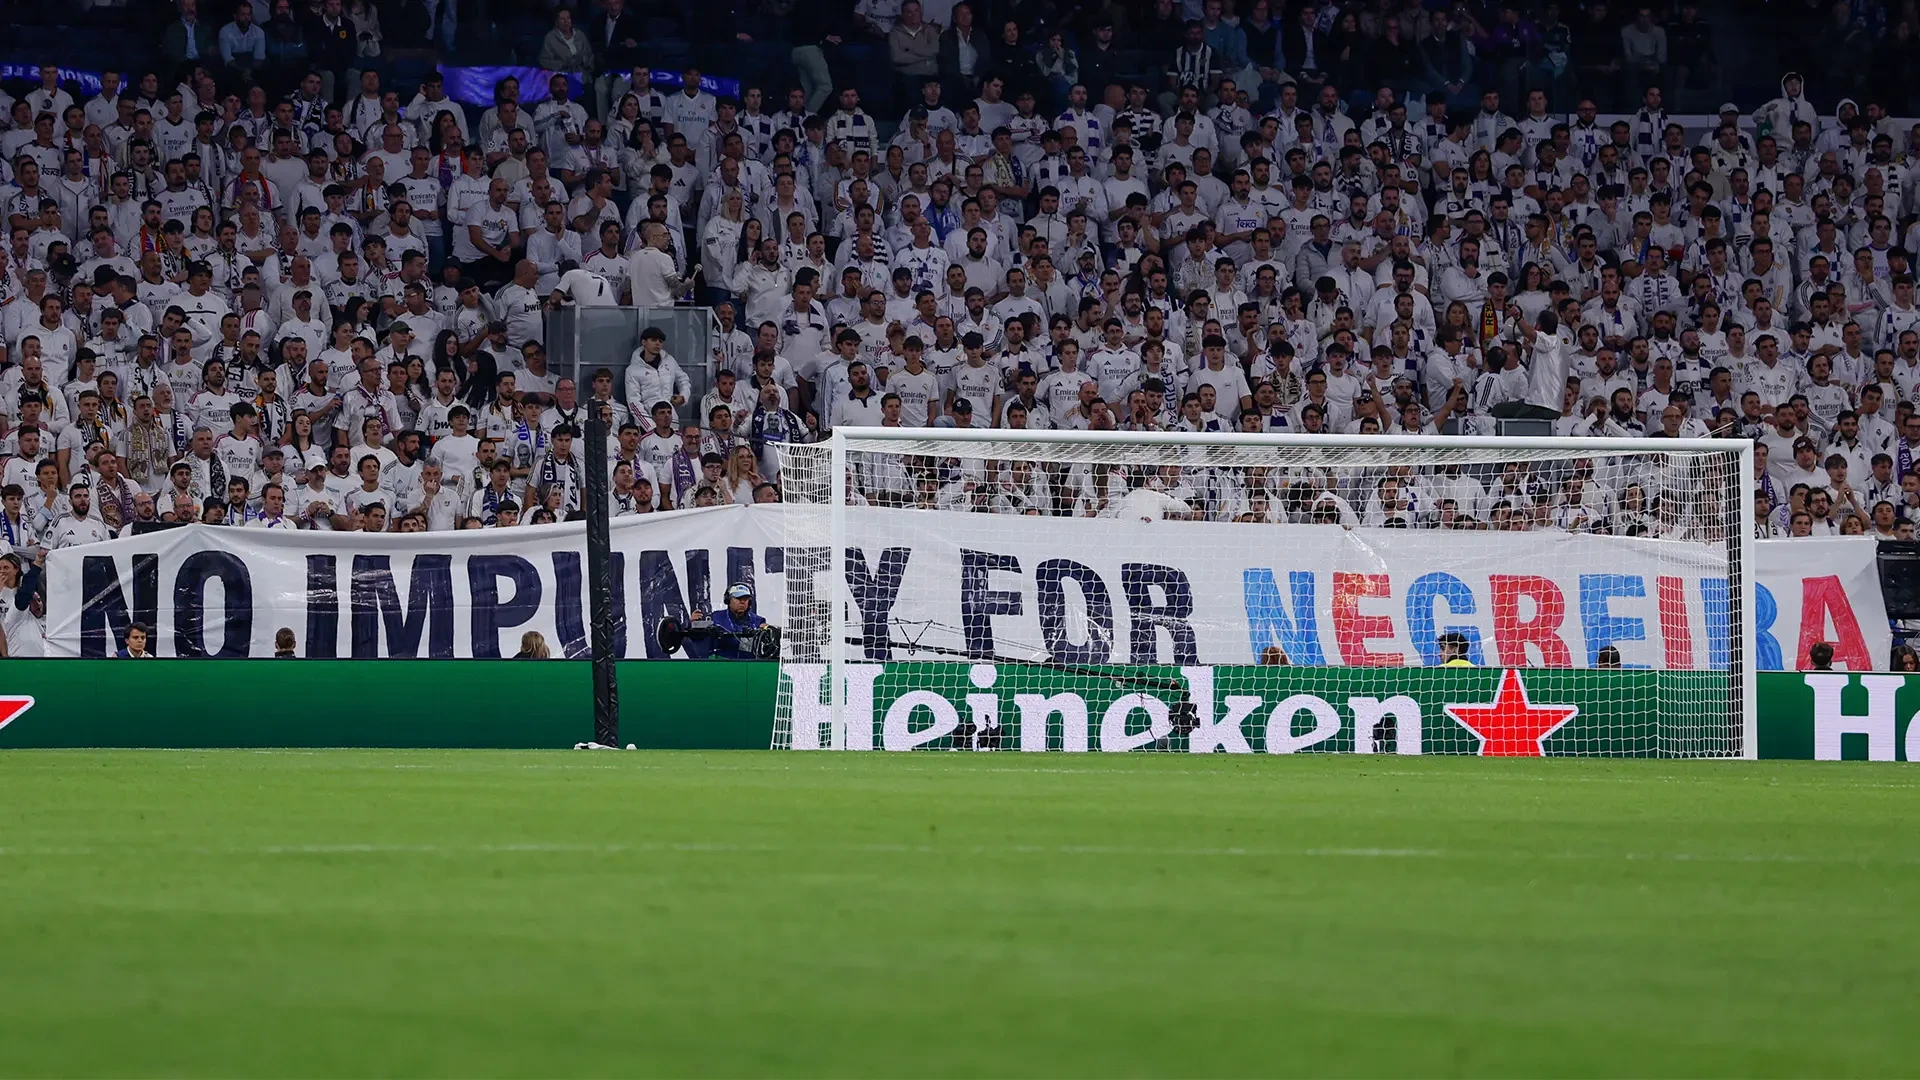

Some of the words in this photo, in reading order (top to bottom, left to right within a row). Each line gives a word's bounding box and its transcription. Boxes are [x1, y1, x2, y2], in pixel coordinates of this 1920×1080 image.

[524, 302, 541, 313] bwi
[592, 276, 604, 297] 7
[80, 551, 253, 659] NO
[306, 546, 911, 659] IMPUNITY
[961, 548, 1200, 664] FOR
[1243, 568, 1873, 671] NEGREIRA
[782, 664, 1422, 754] Heineken
[1804, 674, 1920, 762] H
